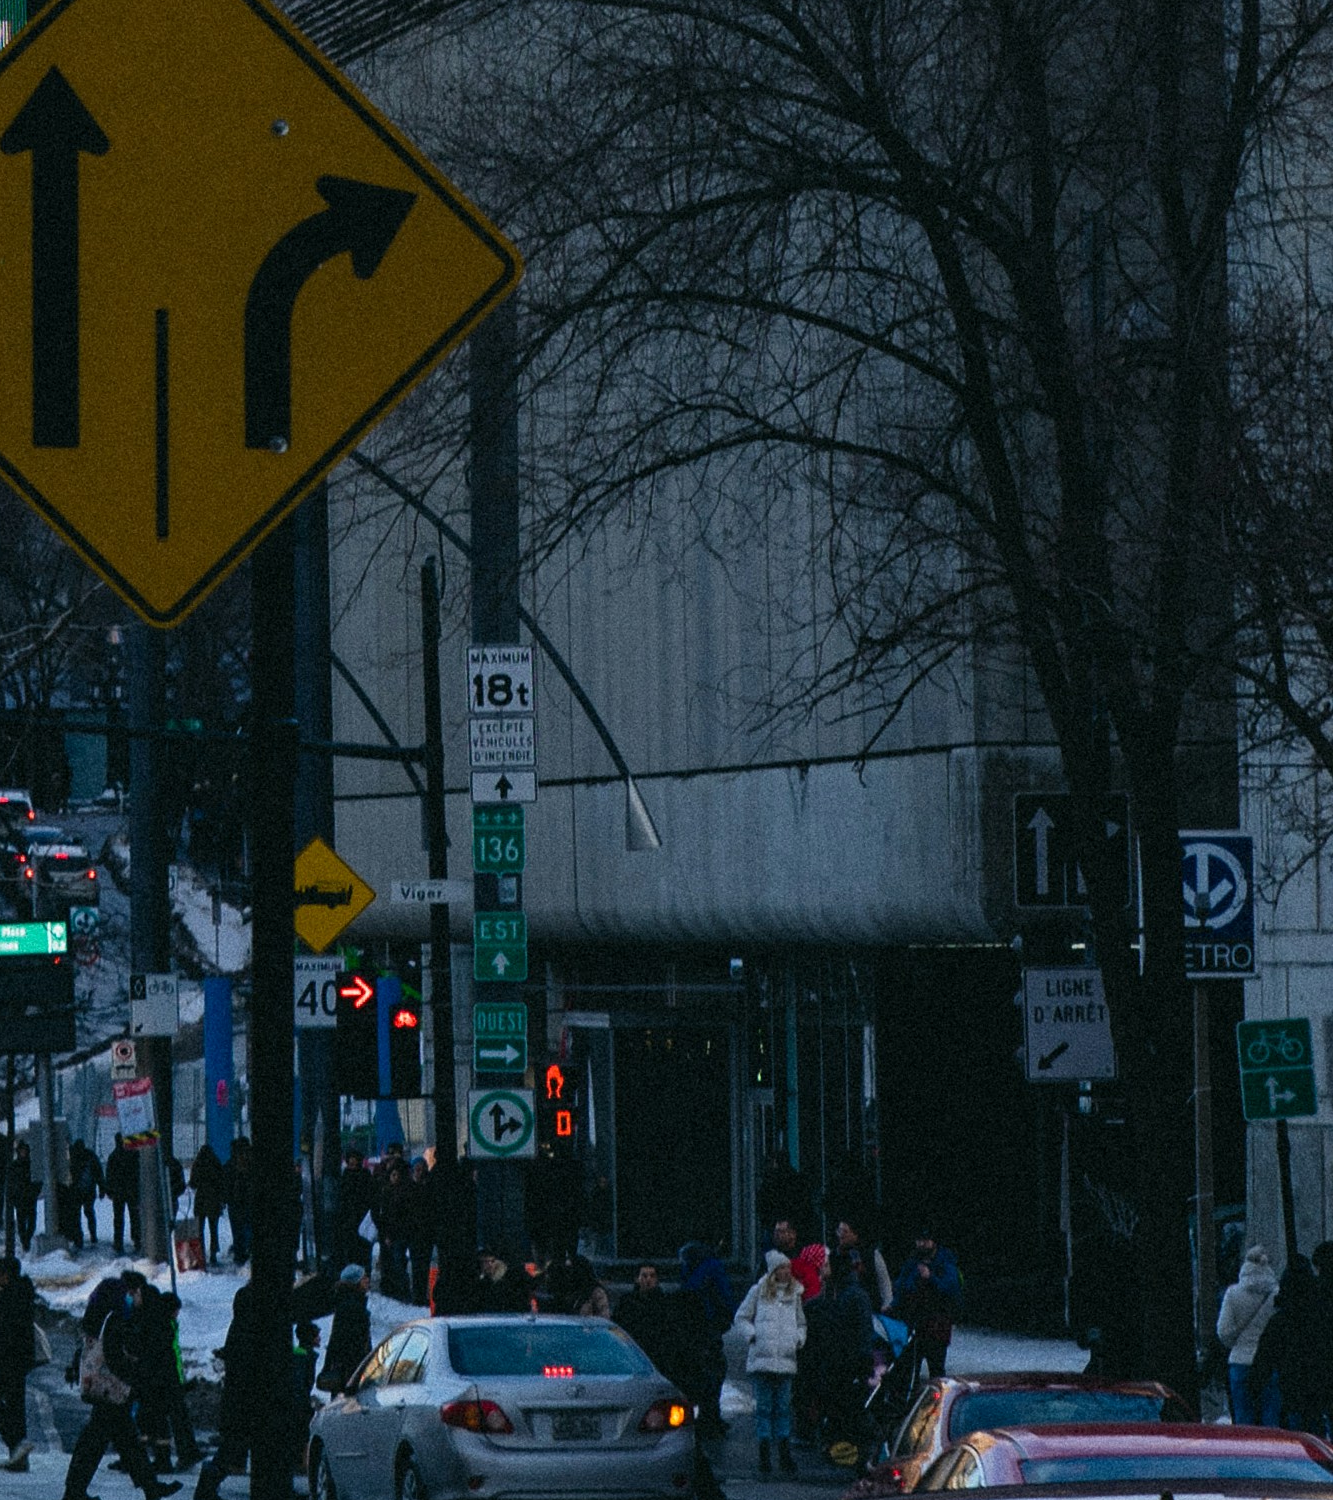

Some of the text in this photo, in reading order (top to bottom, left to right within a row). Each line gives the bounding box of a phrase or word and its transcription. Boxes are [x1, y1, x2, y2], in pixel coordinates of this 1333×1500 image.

[471, 652, 529, 663] MAXIMUM
[473, 673, 529, 707] 18t
[479, 837, 519, 862] 136
[400, 887, 443, 901] Viger
[480, 920, 521, 940] EST
[1185, 943, 1253, 969] ETRO
[296, 962, 342, 972] MAXIMUM
[1046, 978, 1095, 997] LIGNE
[297, 980, 338, 1017] 40
[477, 1011, 523, 1031] OUEST
[1034, 1000, 1105, 1024] D'ARRÊT
